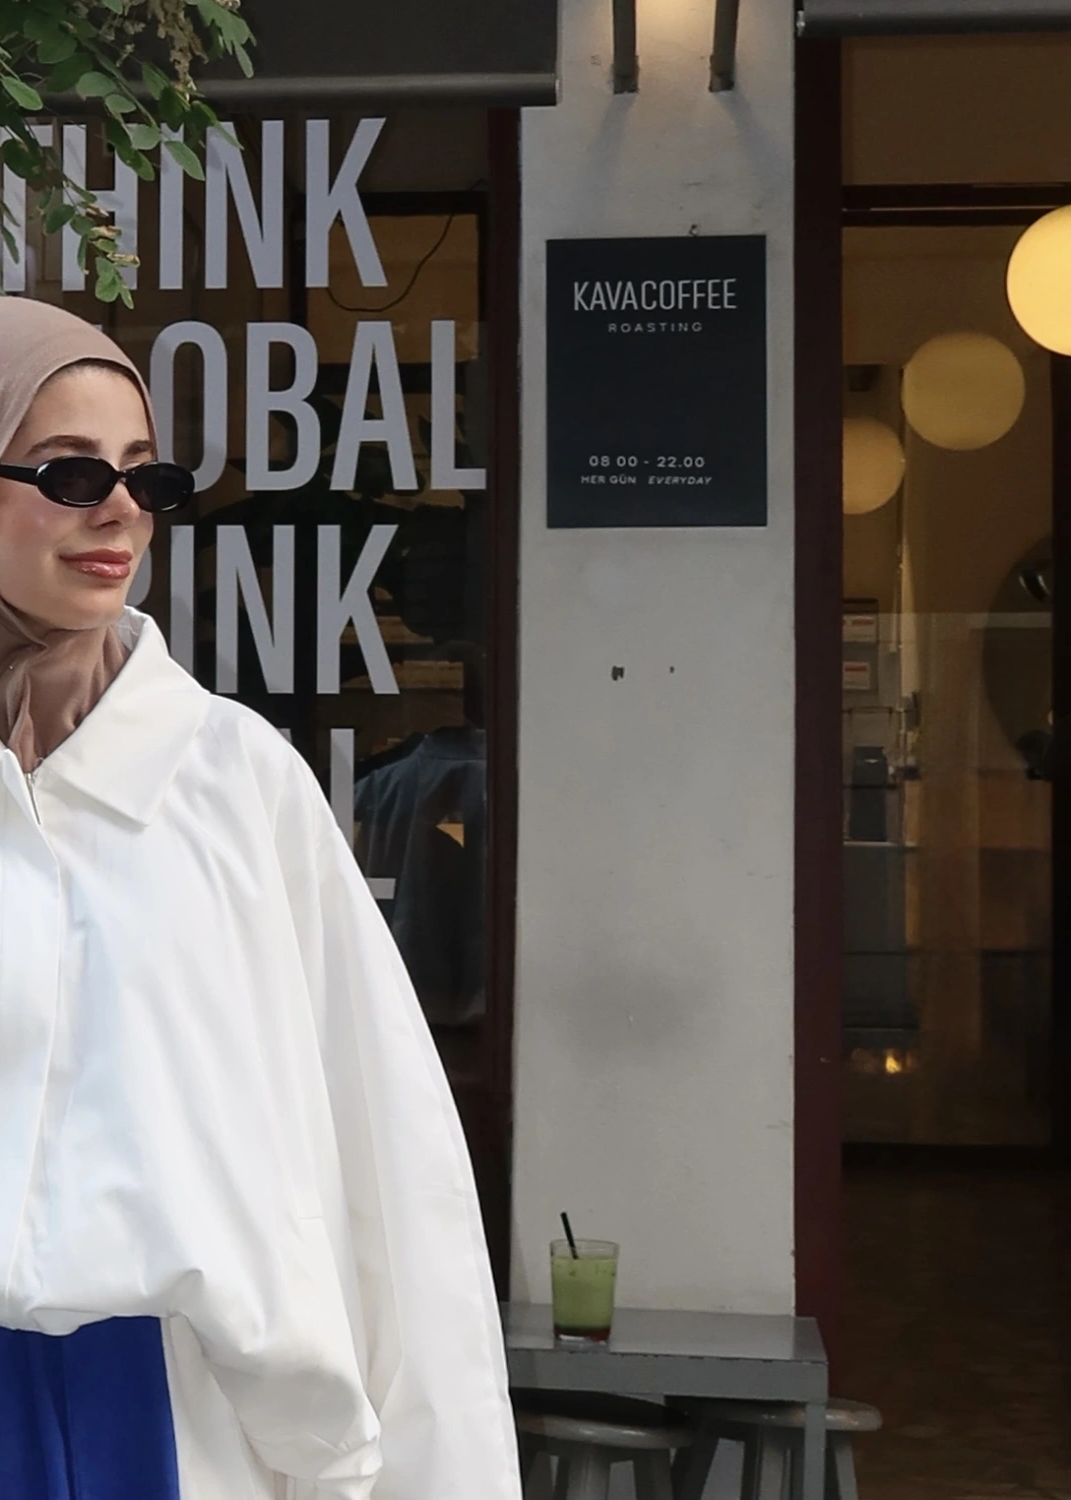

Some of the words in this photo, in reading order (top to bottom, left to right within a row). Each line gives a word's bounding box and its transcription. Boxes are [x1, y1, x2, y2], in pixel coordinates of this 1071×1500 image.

[573, 278, 737, 311] KAVACOFFEE
[608, 321, 703, 333] ROASTING
[101, 319, 487, 492] OBAL
[656, 456, 705, 468] 22.00
[580, 474, 606, 485] HER
[609, 472, 637, 485] GÜN
[647, 475, 713, 486] EVERYDAY
[134, 524, 400, 695] INK
